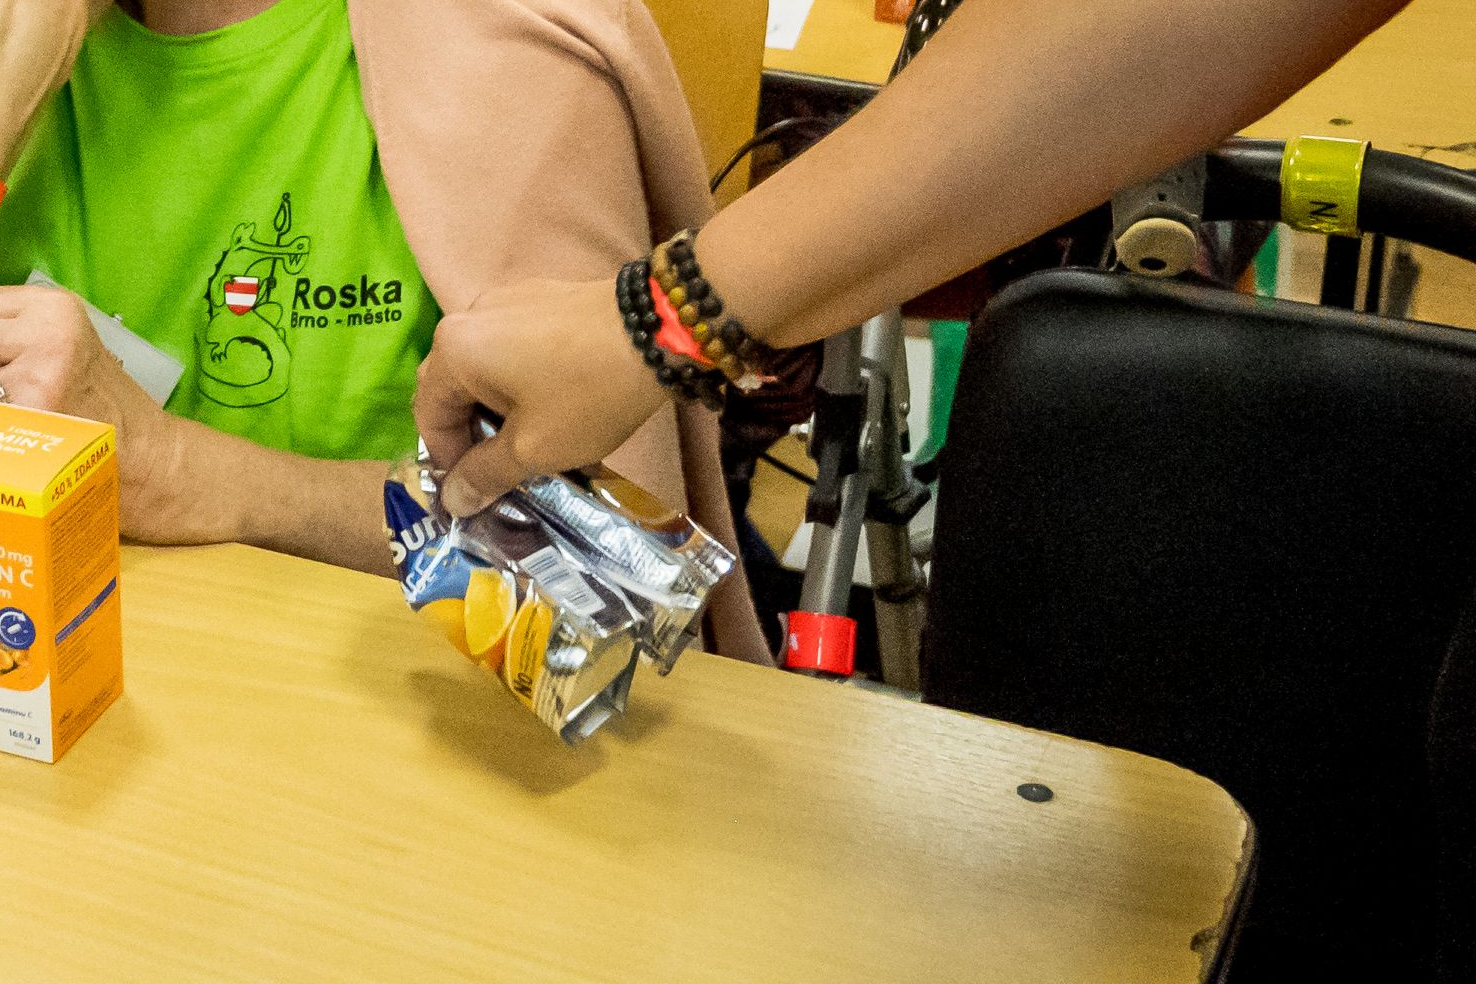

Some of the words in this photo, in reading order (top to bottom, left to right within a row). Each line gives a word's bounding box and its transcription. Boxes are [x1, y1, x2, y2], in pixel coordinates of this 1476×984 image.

[292, 274, 402, 310] Roska
[290, 311, 328, 328] Brno
[346, 308, 402, 327] město
[73, 441, 109, 482] ZDARMA
[7, 550, 33, 568] mg
[19, 569, 35, 588] C
